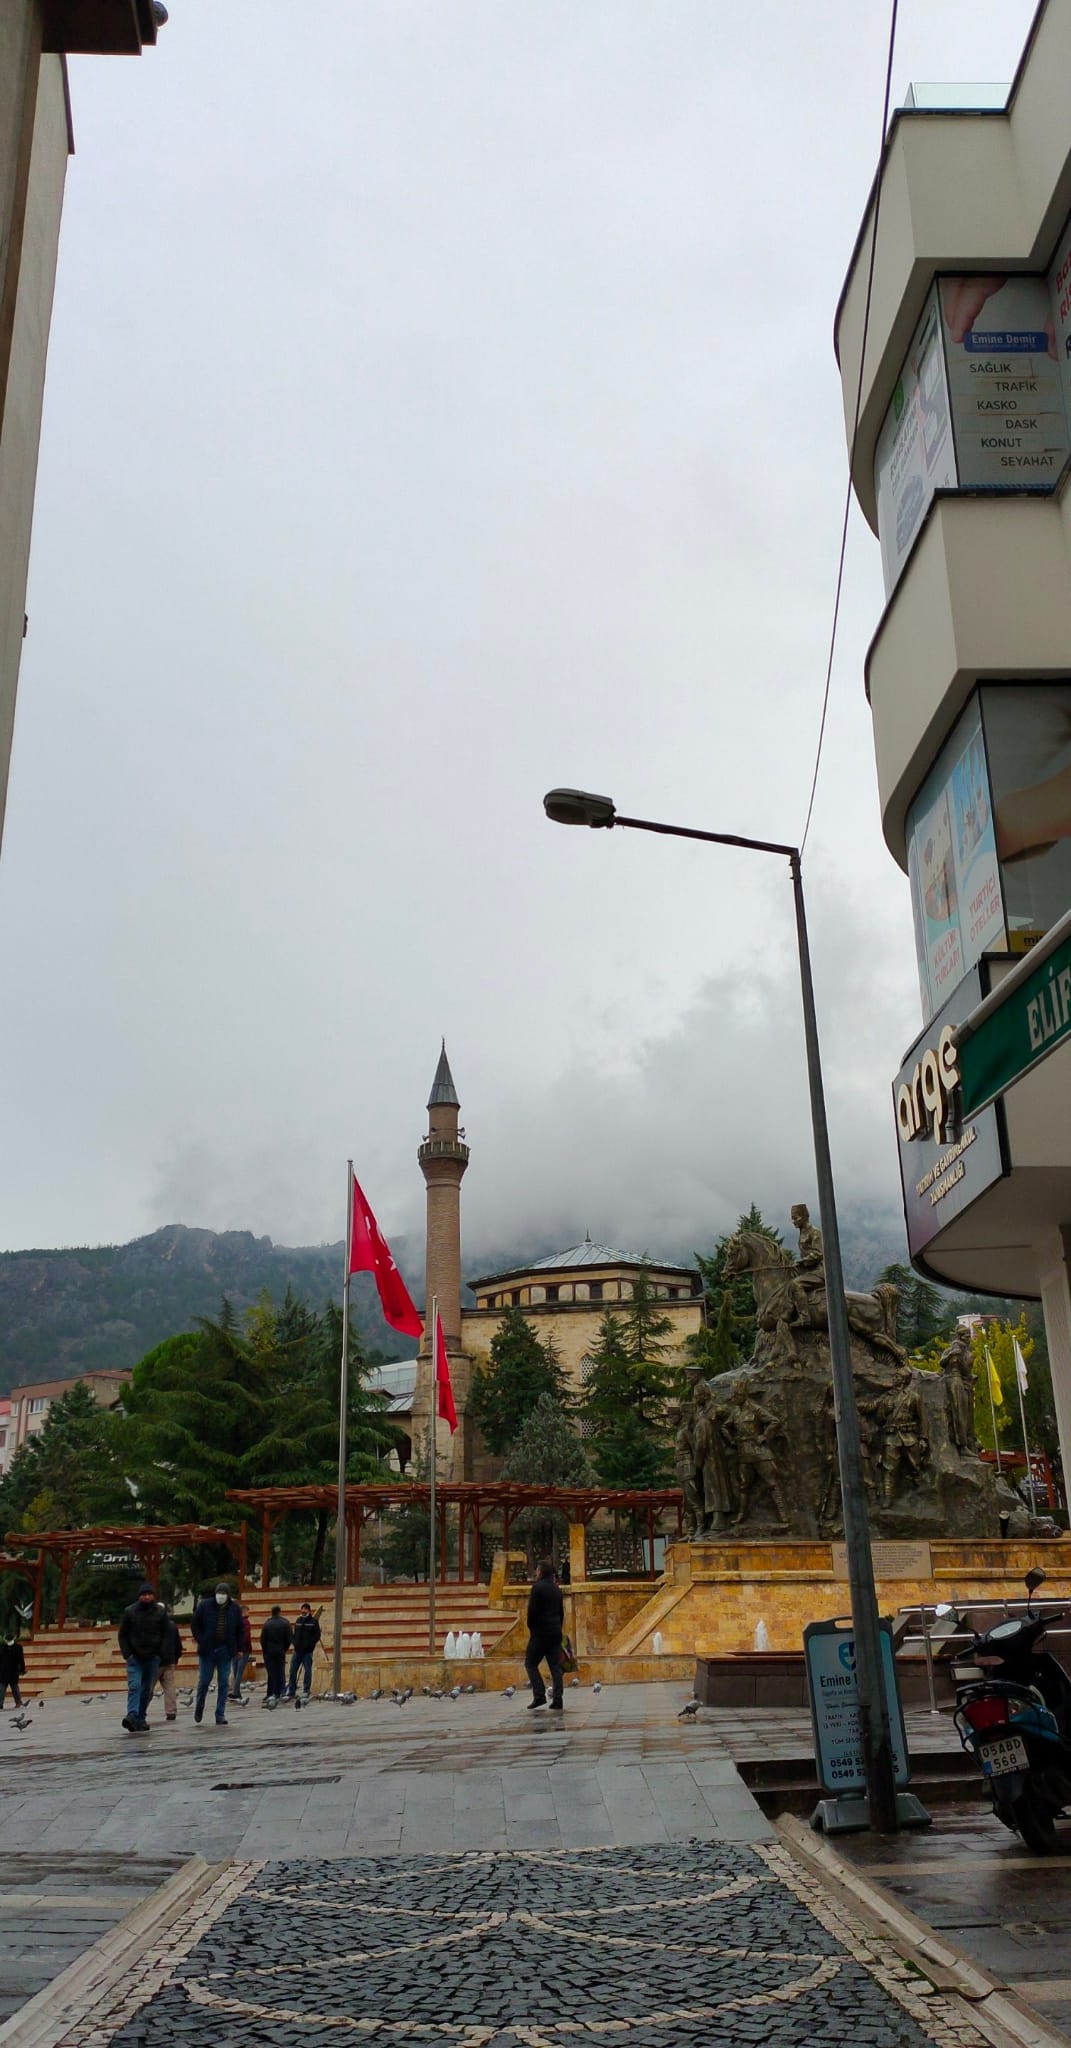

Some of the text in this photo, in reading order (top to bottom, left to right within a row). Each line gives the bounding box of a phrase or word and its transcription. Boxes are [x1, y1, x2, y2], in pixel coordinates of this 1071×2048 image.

[972, 334, 1036, 344] Emine Demir
[969, 361, 1012, 373] SAĞLIK
[995, 381, 1038, 392] TRAFİK
[977, 400, 1018, 410] KASKO
[1005, 419, 1038, 429] DASK
[981, 438, 1022, 448] KONUT
[1000, 456, 1054, 466] SEYAHAT
[970, 895, 1000, 941] OTELLER
[820, 1675, 851, 1688] Emine
[830, 1758, 853, 1768] 0549
[993, 1753, 1018, 1770] 568
[832, 1769, 854, 1779] 0549
